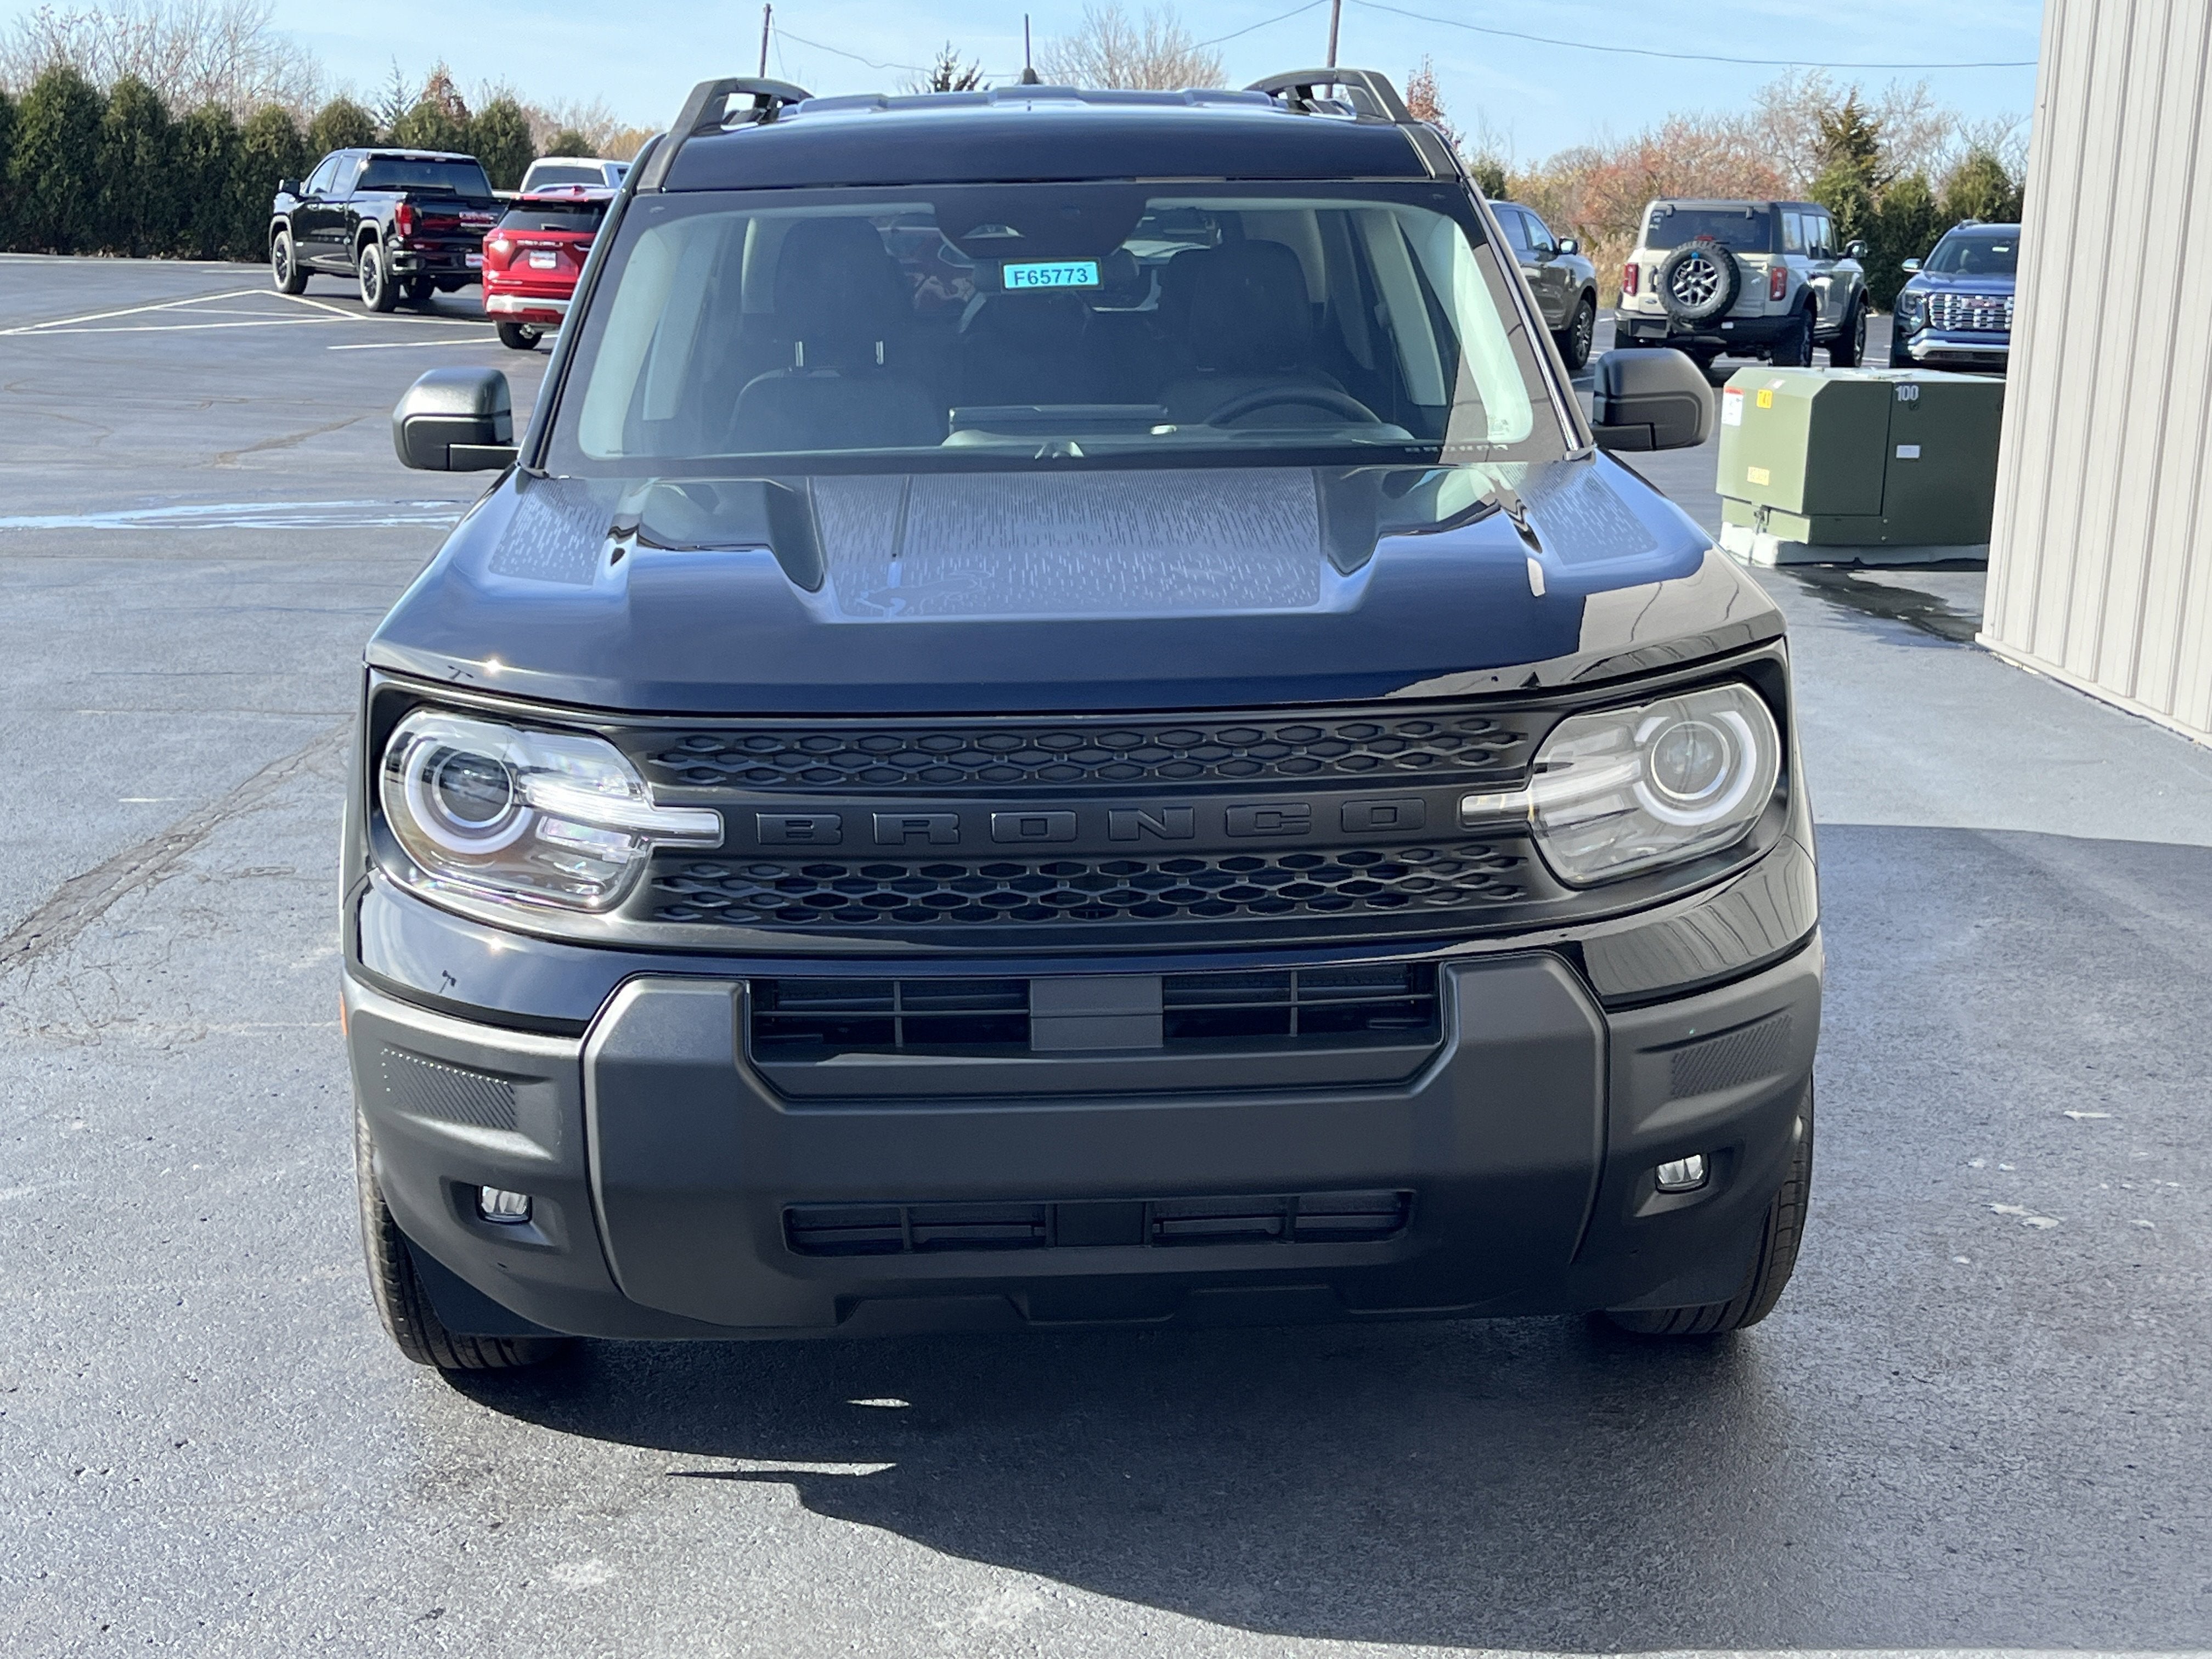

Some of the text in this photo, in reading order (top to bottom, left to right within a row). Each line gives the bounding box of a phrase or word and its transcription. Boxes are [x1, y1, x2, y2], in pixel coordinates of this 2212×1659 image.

[1014, 268, 1088, 285] F65773
[1895, 385, 1918, 401] 100
[755, 797, 1426, 845] BRONCO
